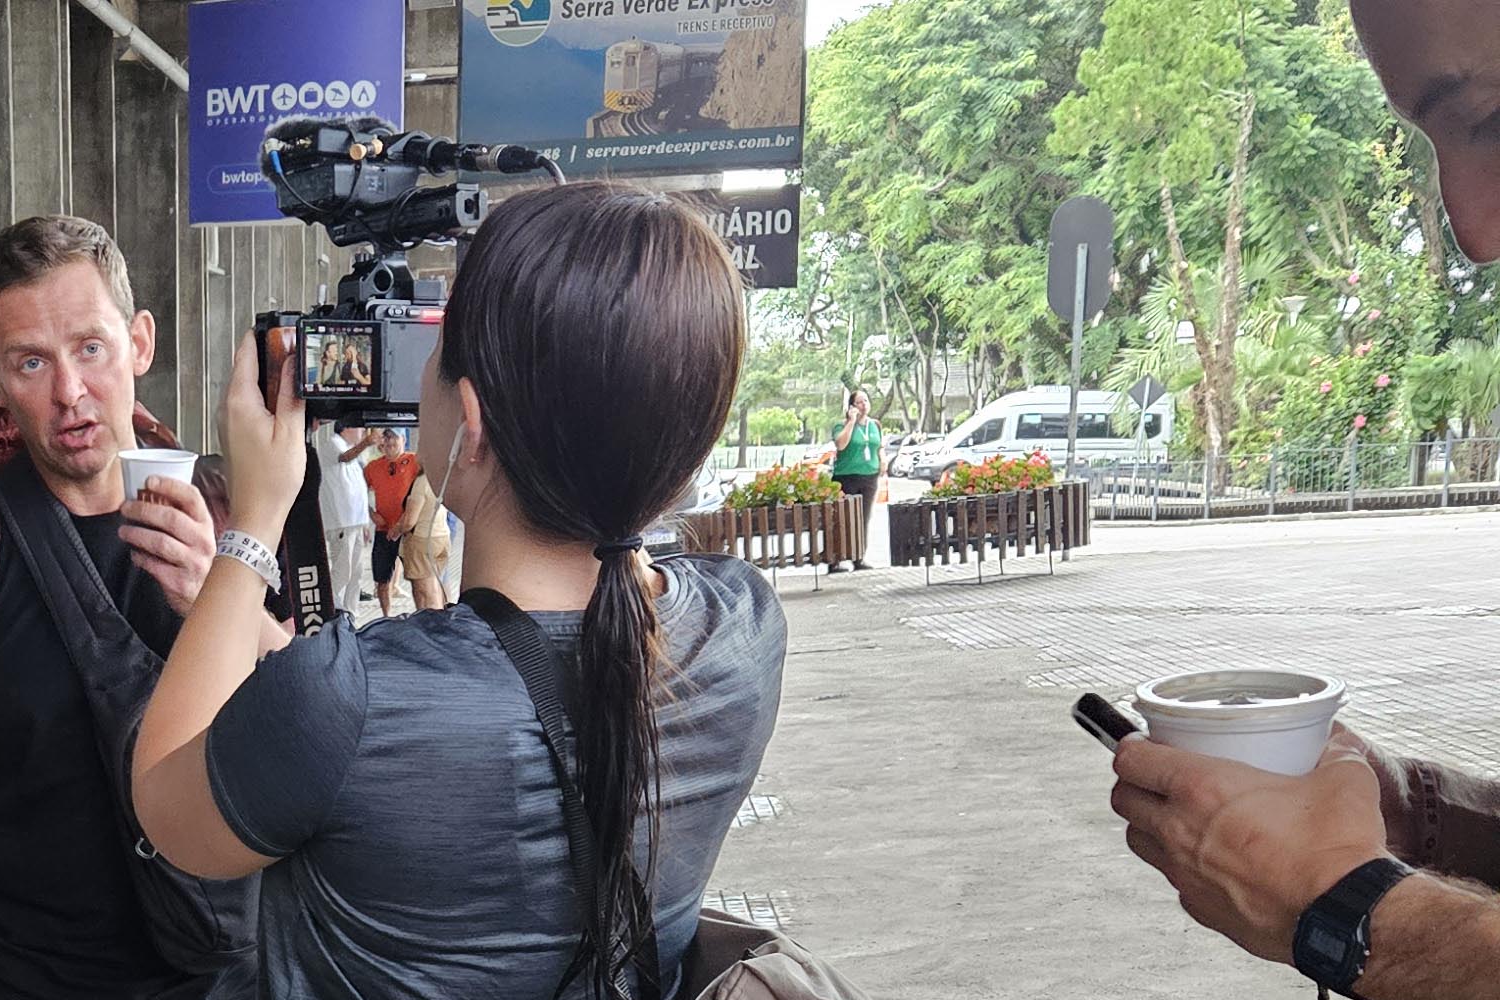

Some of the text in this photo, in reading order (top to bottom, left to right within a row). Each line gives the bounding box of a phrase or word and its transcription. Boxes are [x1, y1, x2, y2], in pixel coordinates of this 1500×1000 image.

[560, 0, 614, 20] Serra
[677, 15, 774, 34] TRENS E RECEPTIVO
[206, 84, 270, 117] BWT
[586, 133, 795, 159] serraverdeexpress.com.br
[222, 170, 269, 185] bwtop
